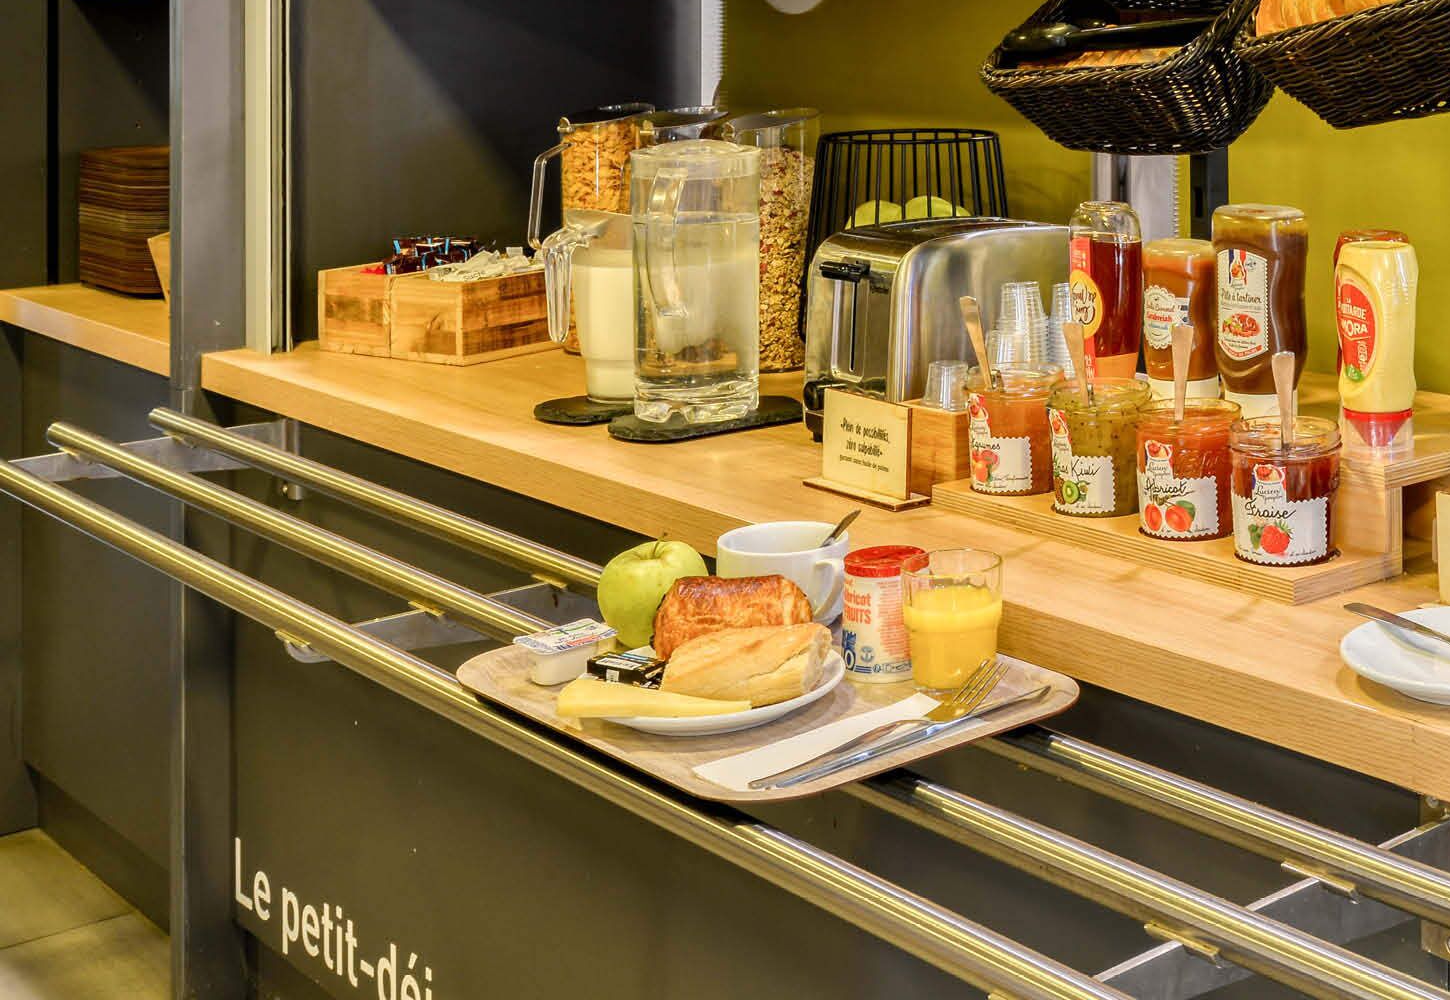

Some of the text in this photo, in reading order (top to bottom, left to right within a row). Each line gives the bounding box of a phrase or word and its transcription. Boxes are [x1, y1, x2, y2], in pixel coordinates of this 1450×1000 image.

[1341, 318, 1368, 337] MORA
[1070, 458, 1101, 481] Kiwi
[1145, 478, 1190, 495] Abricot
[1245, 497, 1296, 519] Fraise
[235, 837, 271, 921] Le
